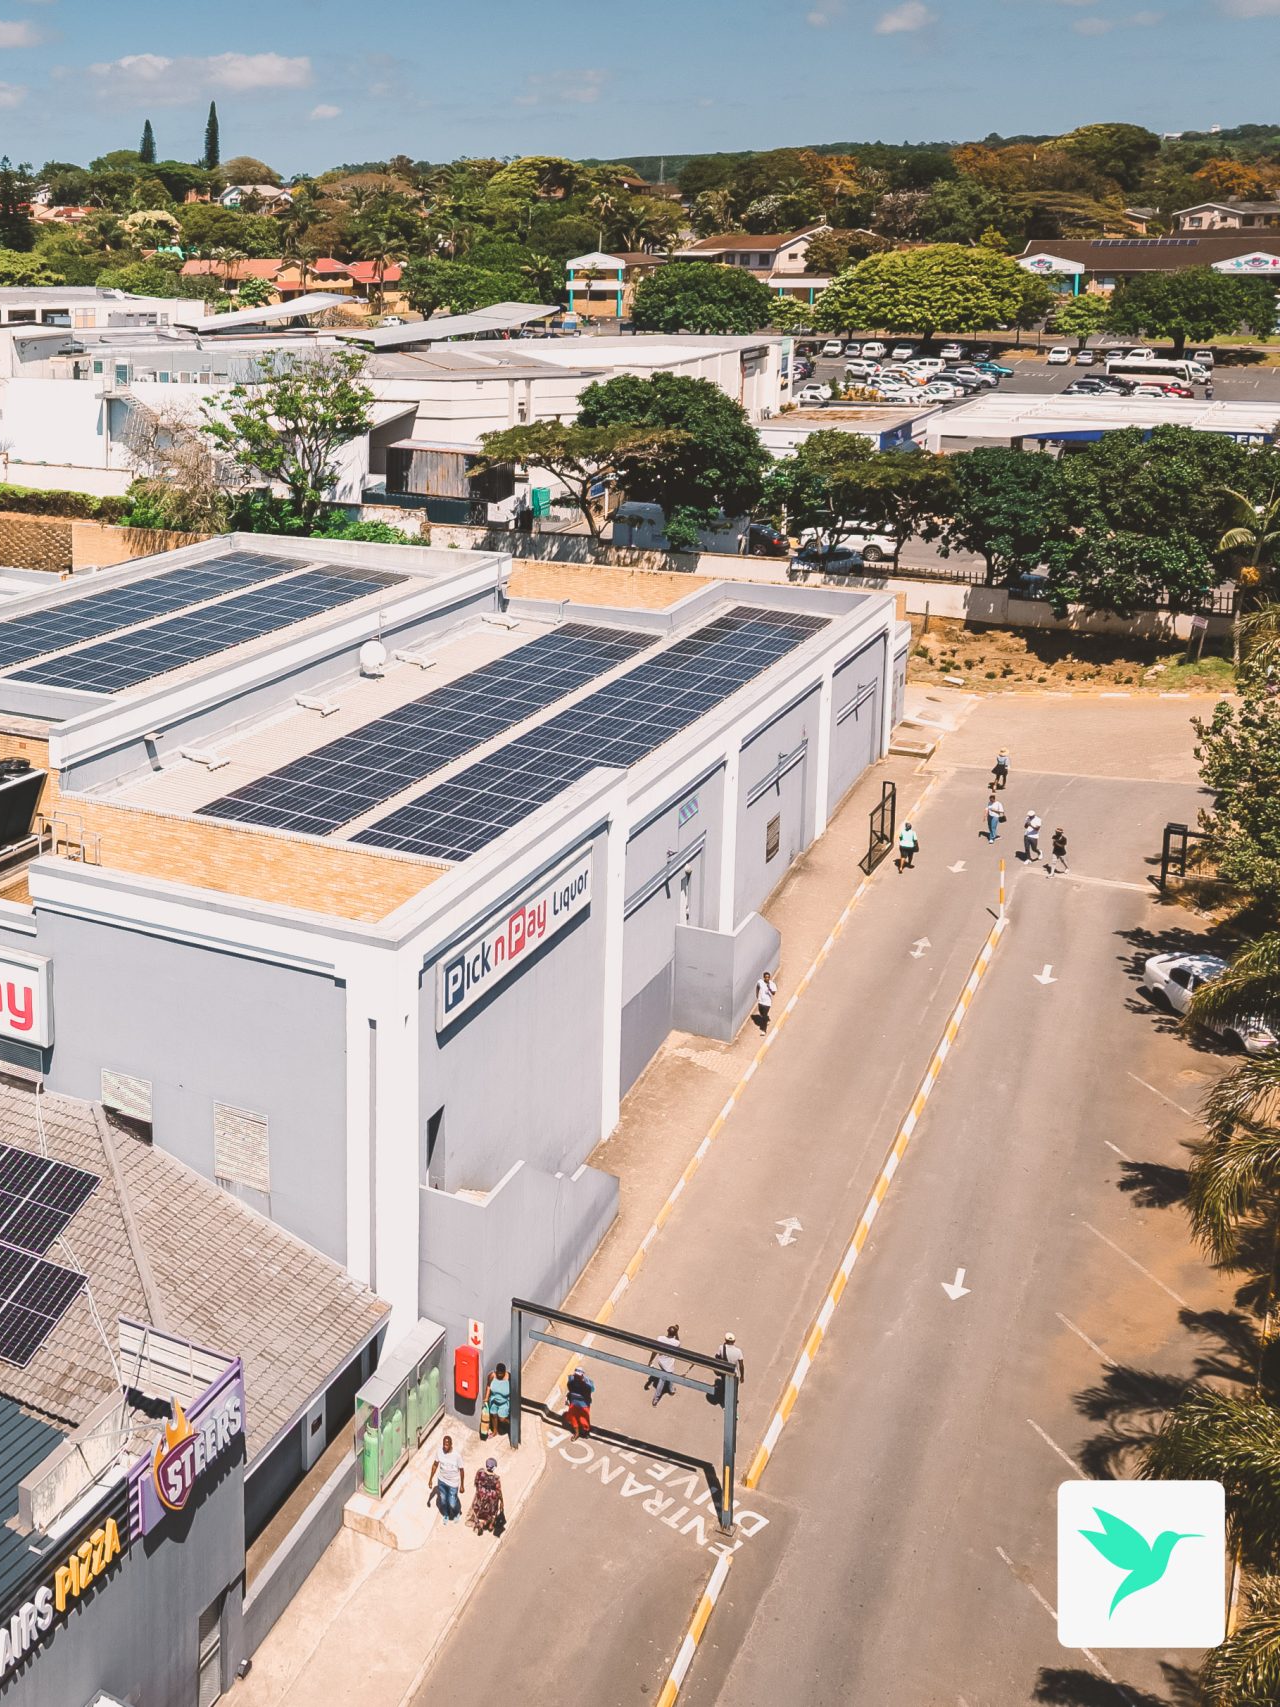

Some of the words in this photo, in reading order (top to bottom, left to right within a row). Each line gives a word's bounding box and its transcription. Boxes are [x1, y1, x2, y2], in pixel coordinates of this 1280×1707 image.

[445, 955, 491, 1014] Pick
[494, 935, 505, 967] n
[508, 900, 546, 960] Pay
[553, 869, 589, 916] Liquor
[167, 1396, 242, 1503] STEERS
[55, 1517, 121, 1612] PIZZA
